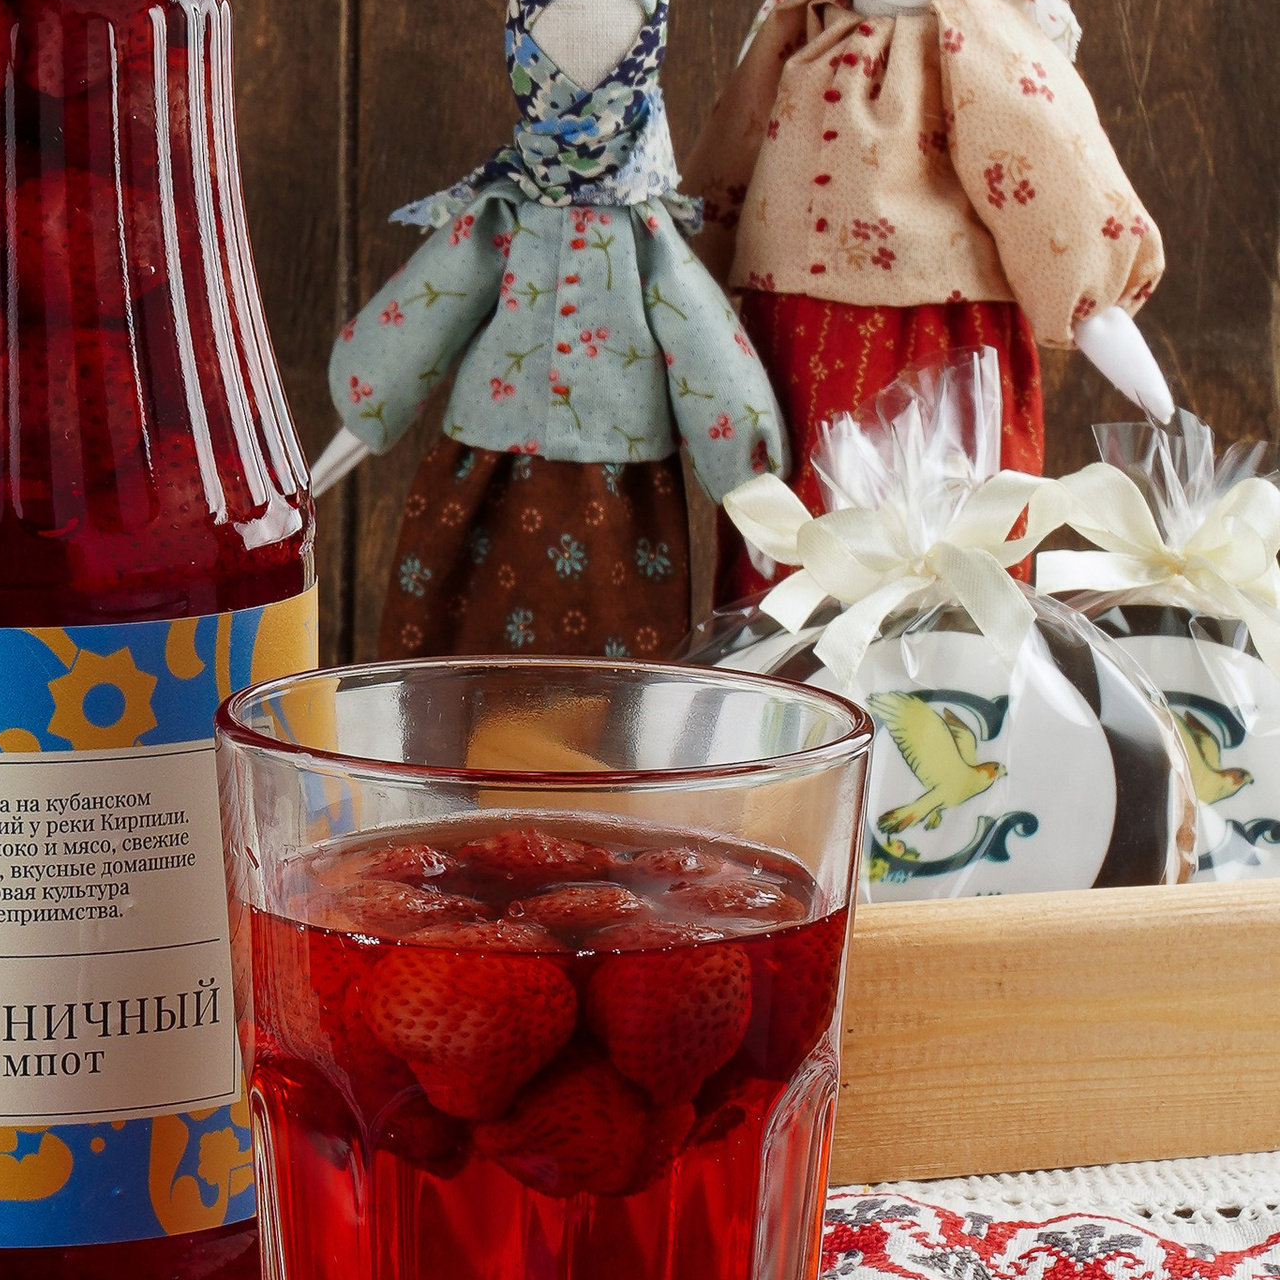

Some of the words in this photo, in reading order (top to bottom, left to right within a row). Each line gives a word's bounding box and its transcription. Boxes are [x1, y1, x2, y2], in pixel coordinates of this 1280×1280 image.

[16, 798, 40, 813] на
[45, 790, 152, 814] кубанском
[29, 822, 41, 838] у
[46, 819, 95, 837] реки
[100, 810, 190, 833] Кирпили.
[44, 842, 57, 856] и
[63, 839, 117, 858] мясо,
[122, 830, 190, 852] свежие
[10, 865, 96, 882] вкусные
[101, 851, 197, 879] домашние
[41, 880, 130, 901] культура
